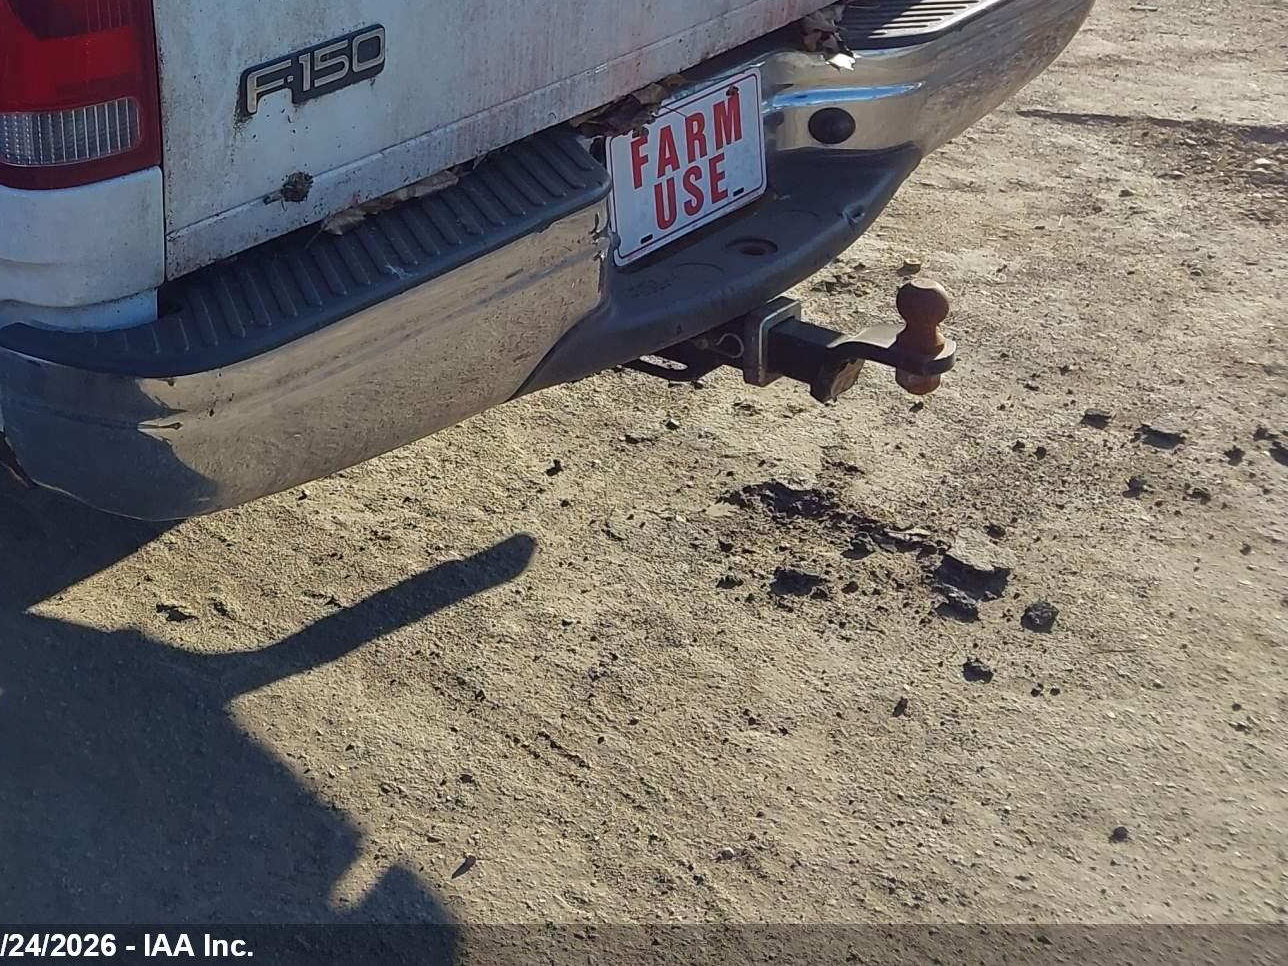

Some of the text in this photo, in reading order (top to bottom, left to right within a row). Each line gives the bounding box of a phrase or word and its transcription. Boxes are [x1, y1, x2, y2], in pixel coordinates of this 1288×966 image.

[245, 26, 386, 114] F-150
[630, 91, 743, 190] FARM
[654, 152, 729, 230] USE
